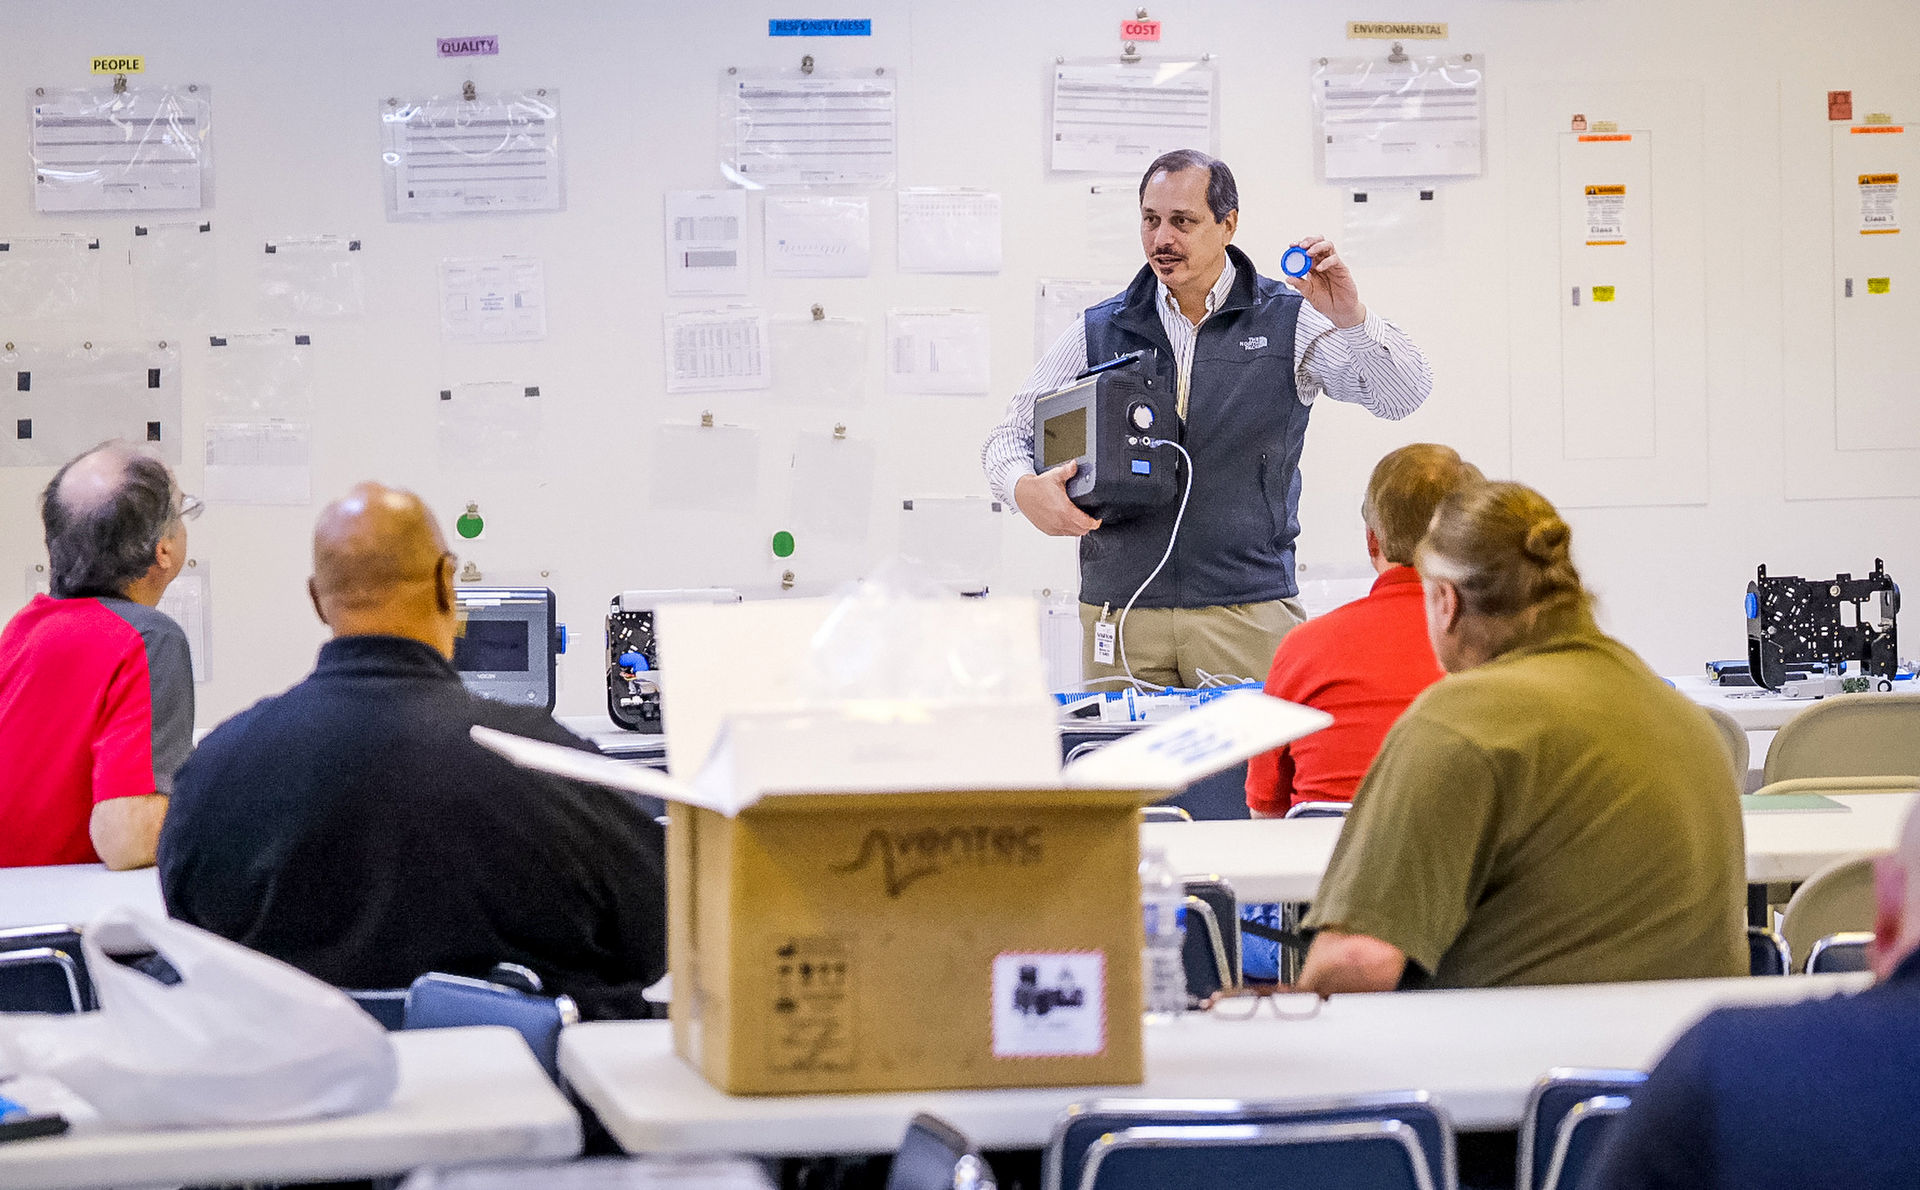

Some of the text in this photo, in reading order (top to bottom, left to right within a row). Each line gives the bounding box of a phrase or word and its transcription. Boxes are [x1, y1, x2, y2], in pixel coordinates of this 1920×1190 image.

[776, 20, 865, 31] RESPONSIVENESS
[1126, 24, 1157, 35] COST
[1353, 24, 1442, 35] ENVIRONMENTAL
[441, 40, 493, 53] QUALITY
[93, 59, 140, 70] PEOPLE
